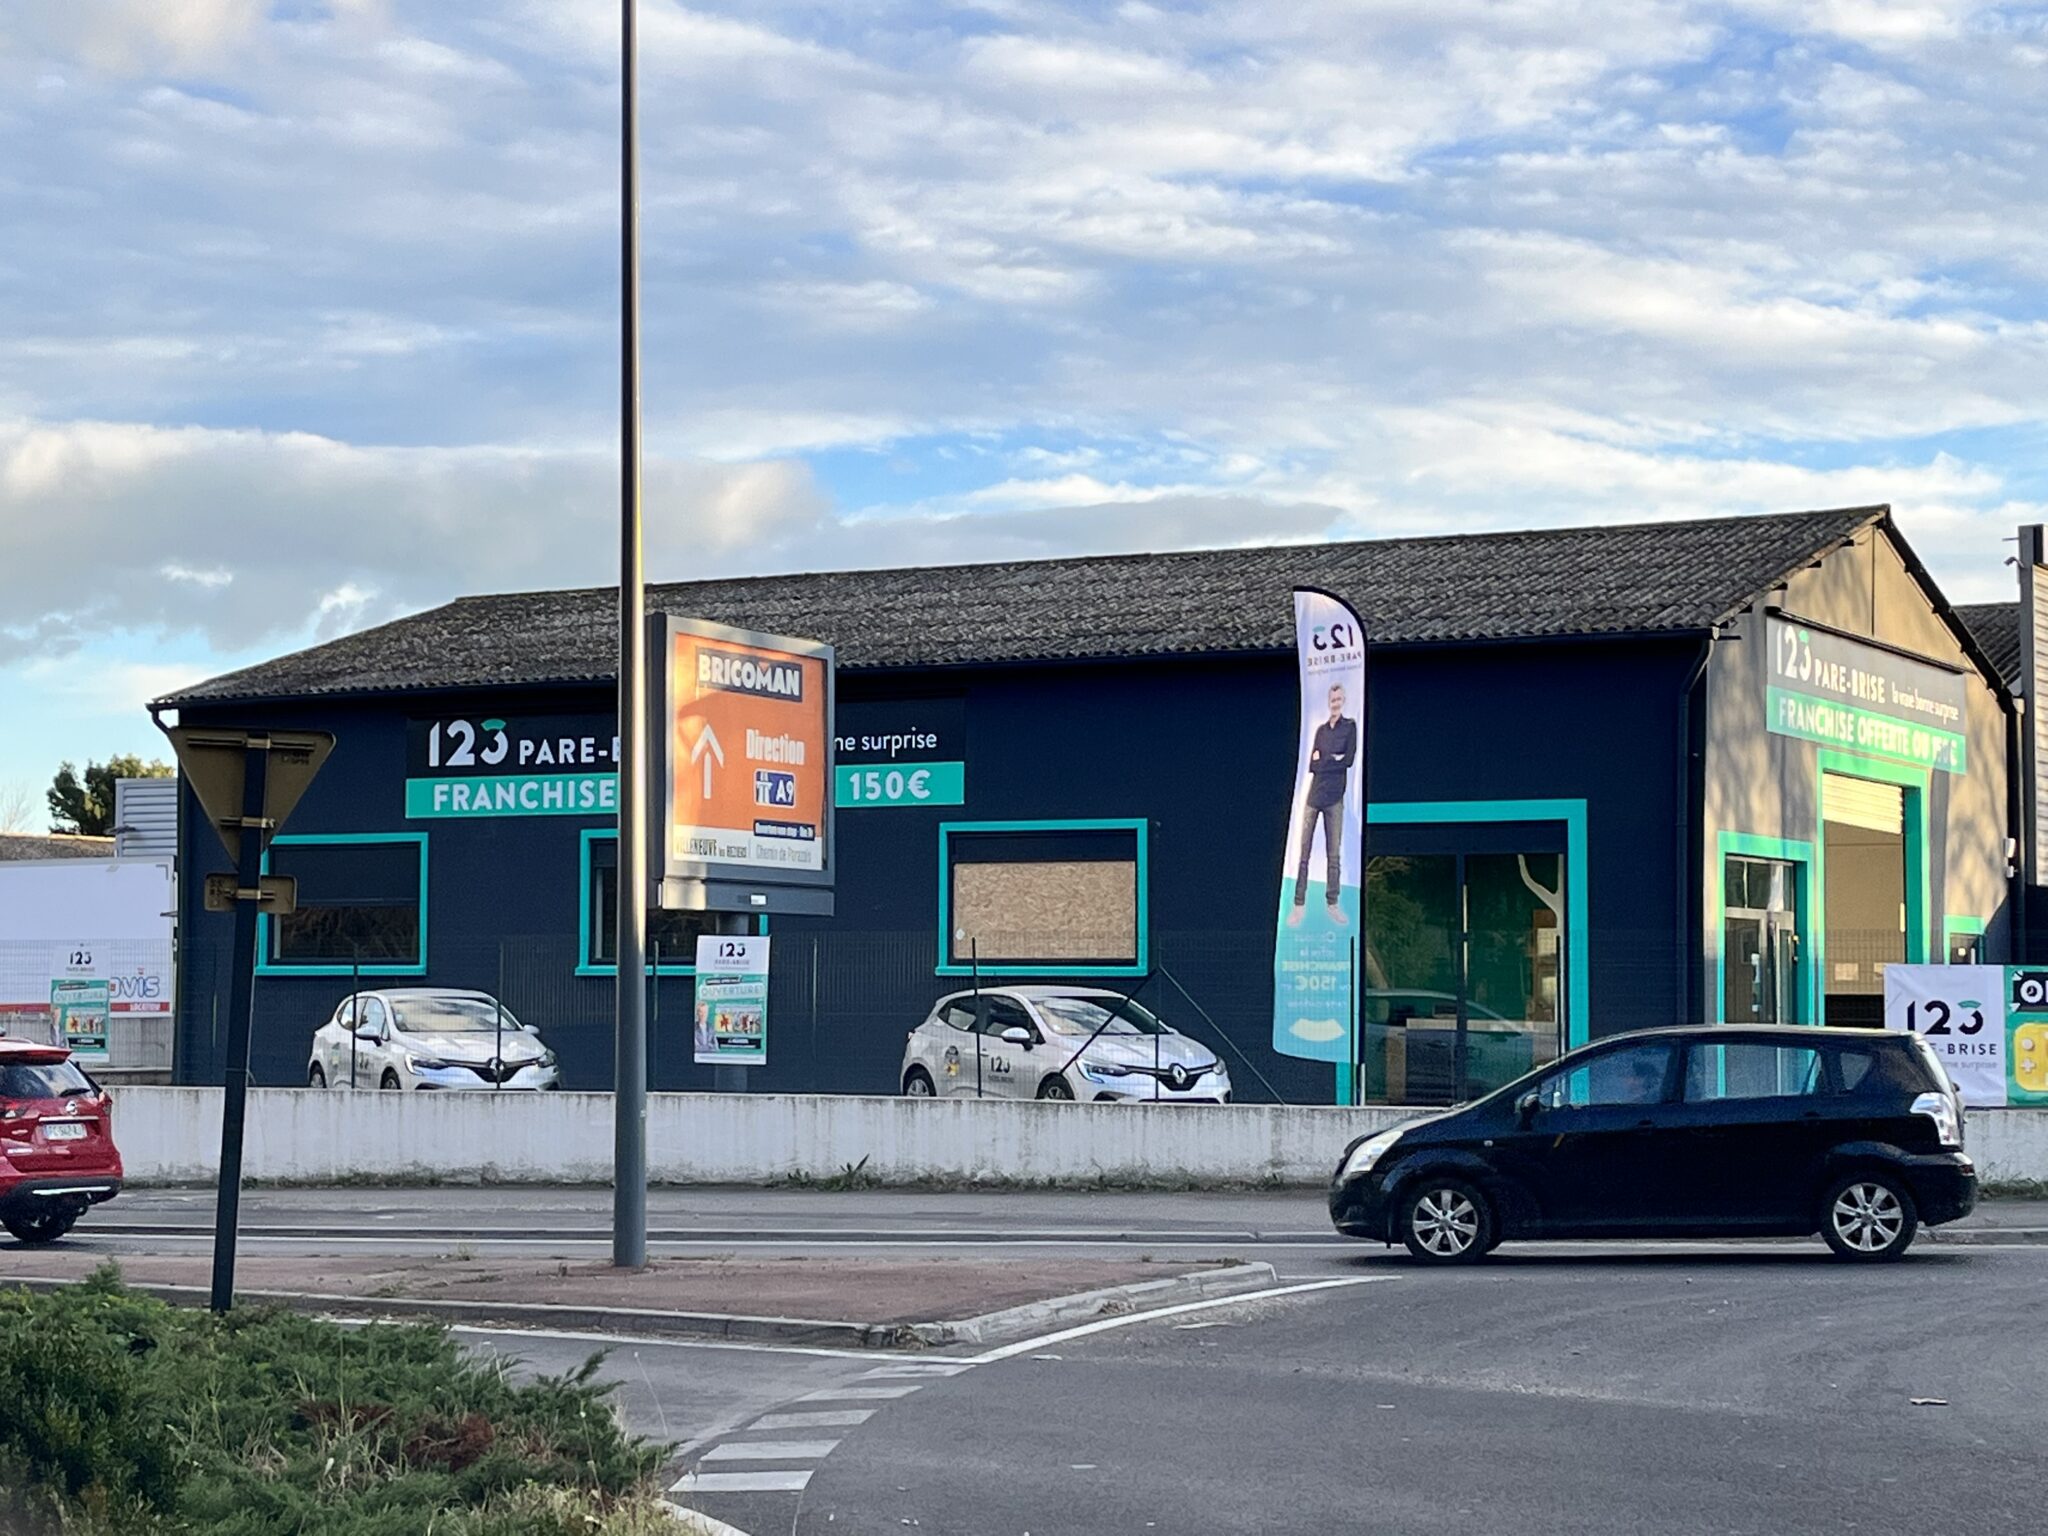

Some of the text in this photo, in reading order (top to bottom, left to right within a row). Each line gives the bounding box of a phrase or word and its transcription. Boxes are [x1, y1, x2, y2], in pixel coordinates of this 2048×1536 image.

[698, 654, 800, 696] BRICOMAN
[1776, 625, 1812, 682] 123
[1814, 658, 1886, 704] PARE-BRISE
[1779, 696, 1854, 742] FRANCHISE
[429, 718, 509, 767] 123
[746, 729, 805, 765] Direction
[861, 726, 938, 758] surprise
[433, 779, 616, 812] FRANCHISE
[775, 780, 794, 803] A9
[849, 769, 931, 800] 150€
[70, 951, 92, 965] 123
[720, 943, 746, 957] 123
[1907, 1000, 1983, 1035] 123
[991, 1056, 1011, 1073] 123
